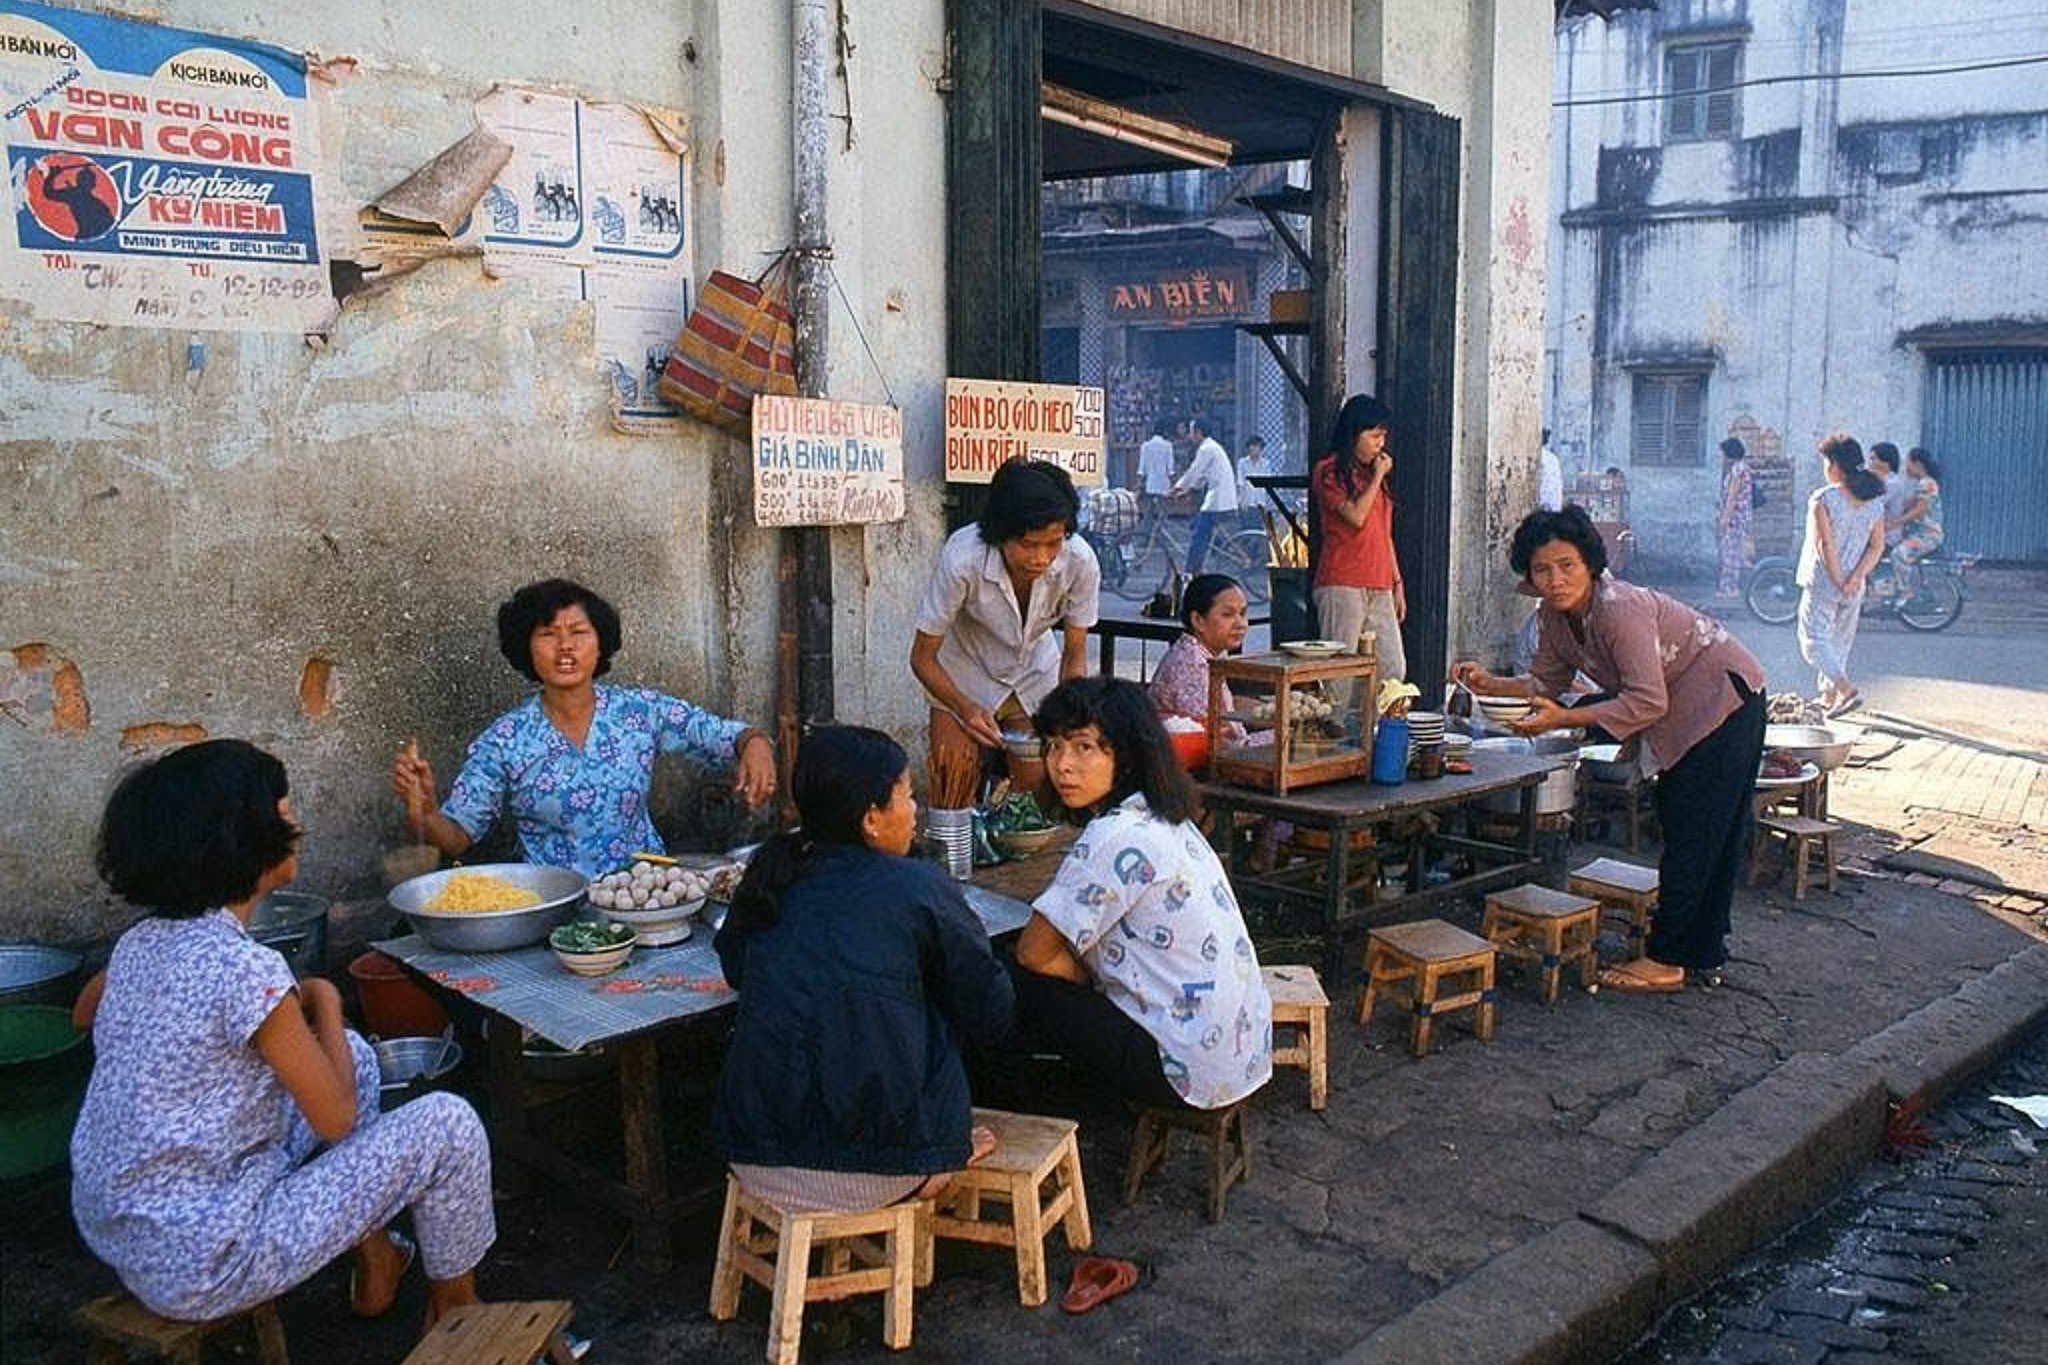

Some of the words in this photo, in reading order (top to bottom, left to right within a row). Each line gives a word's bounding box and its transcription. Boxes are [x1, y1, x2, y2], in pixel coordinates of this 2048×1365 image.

[158, 123, 291, 167] CÔNG
[948, 385, 980, 429] BÚN
[984, 386, 1009, 431] BÒ
[1012, 388, 1038, 432] GIÒ
[1042, 401, 1073, 433] HEO
[1075, 388, 1101, 413] 700
[1074, 415, 1101, 438] 500
[759, 436, 791, 469] GIÁ
[796, 439, 841, 470] BÌNH
[845, 439, 885, 472] DÂN
[948, 432, 983, 472] BÚN
